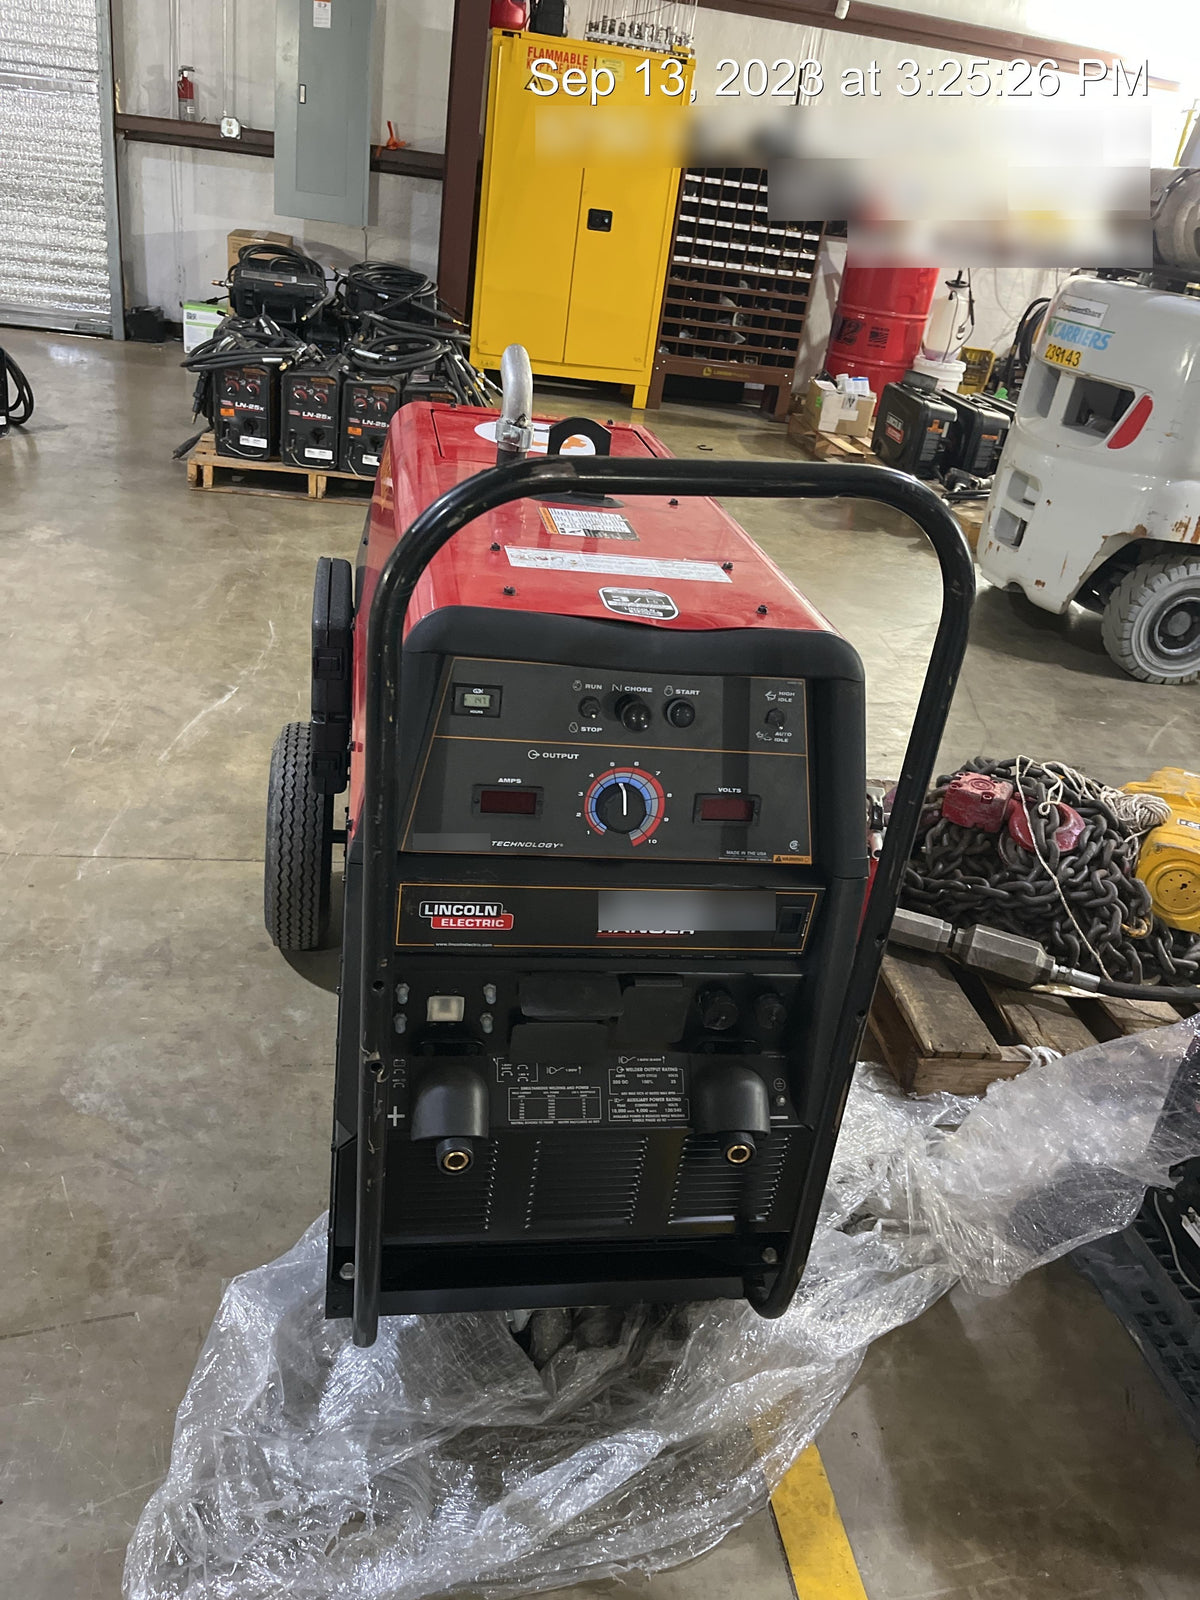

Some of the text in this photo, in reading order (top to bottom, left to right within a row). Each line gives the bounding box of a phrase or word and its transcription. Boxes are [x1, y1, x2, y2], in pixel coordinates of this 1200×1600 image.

[528, 46, 589, 66] FLAMMABLE
[1053, 321, 1113, 351] CARRIERS
[1045, 344, 1081, 367] 239143
[542, 752, 580, 760] OUTPUT
[424, 904, 498, 916] LINCOLN
[441, 918, 505, 927] ELECTRIC
